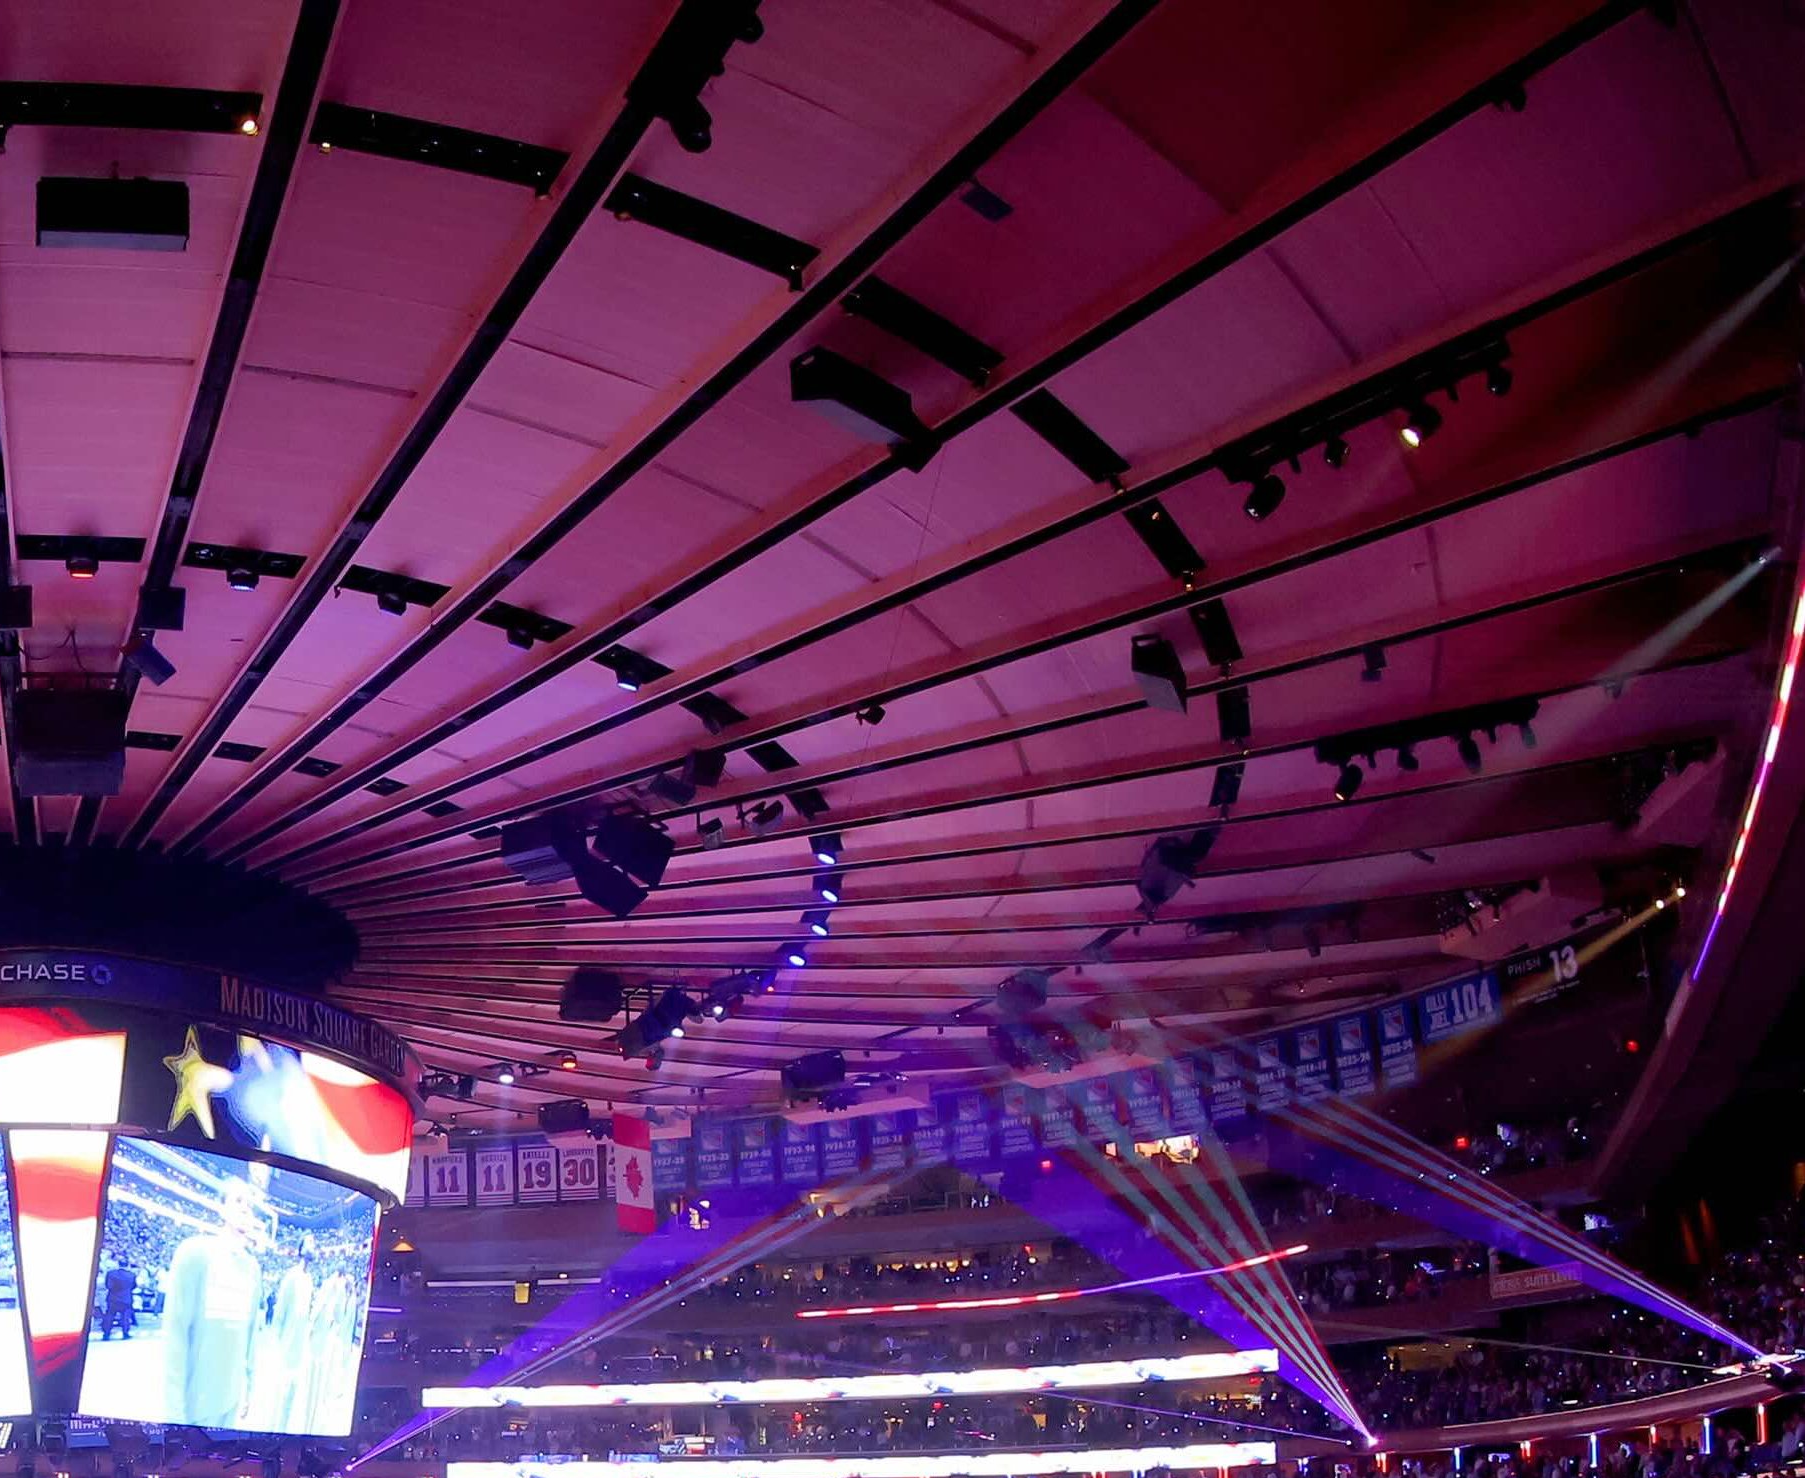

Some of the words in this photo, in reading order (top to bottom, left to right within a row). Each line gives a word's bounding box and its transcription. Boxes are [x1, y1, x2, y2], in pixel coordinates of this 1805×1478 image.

[0, 963, 85, 982] CHASE
[1507, 956, 1542, 977] PHISH
[1549, 945, 1579, 983] 13
[220, 975, 309, 1034] MADISON
[1450, 977, 1495, 1024] 104
[436, 1165, 460, 1193] 11
[483, 1164, 506, 1192] 11
[523, 1161, 552, 1189] 19
[563, 1158, 596, 1187] 30
